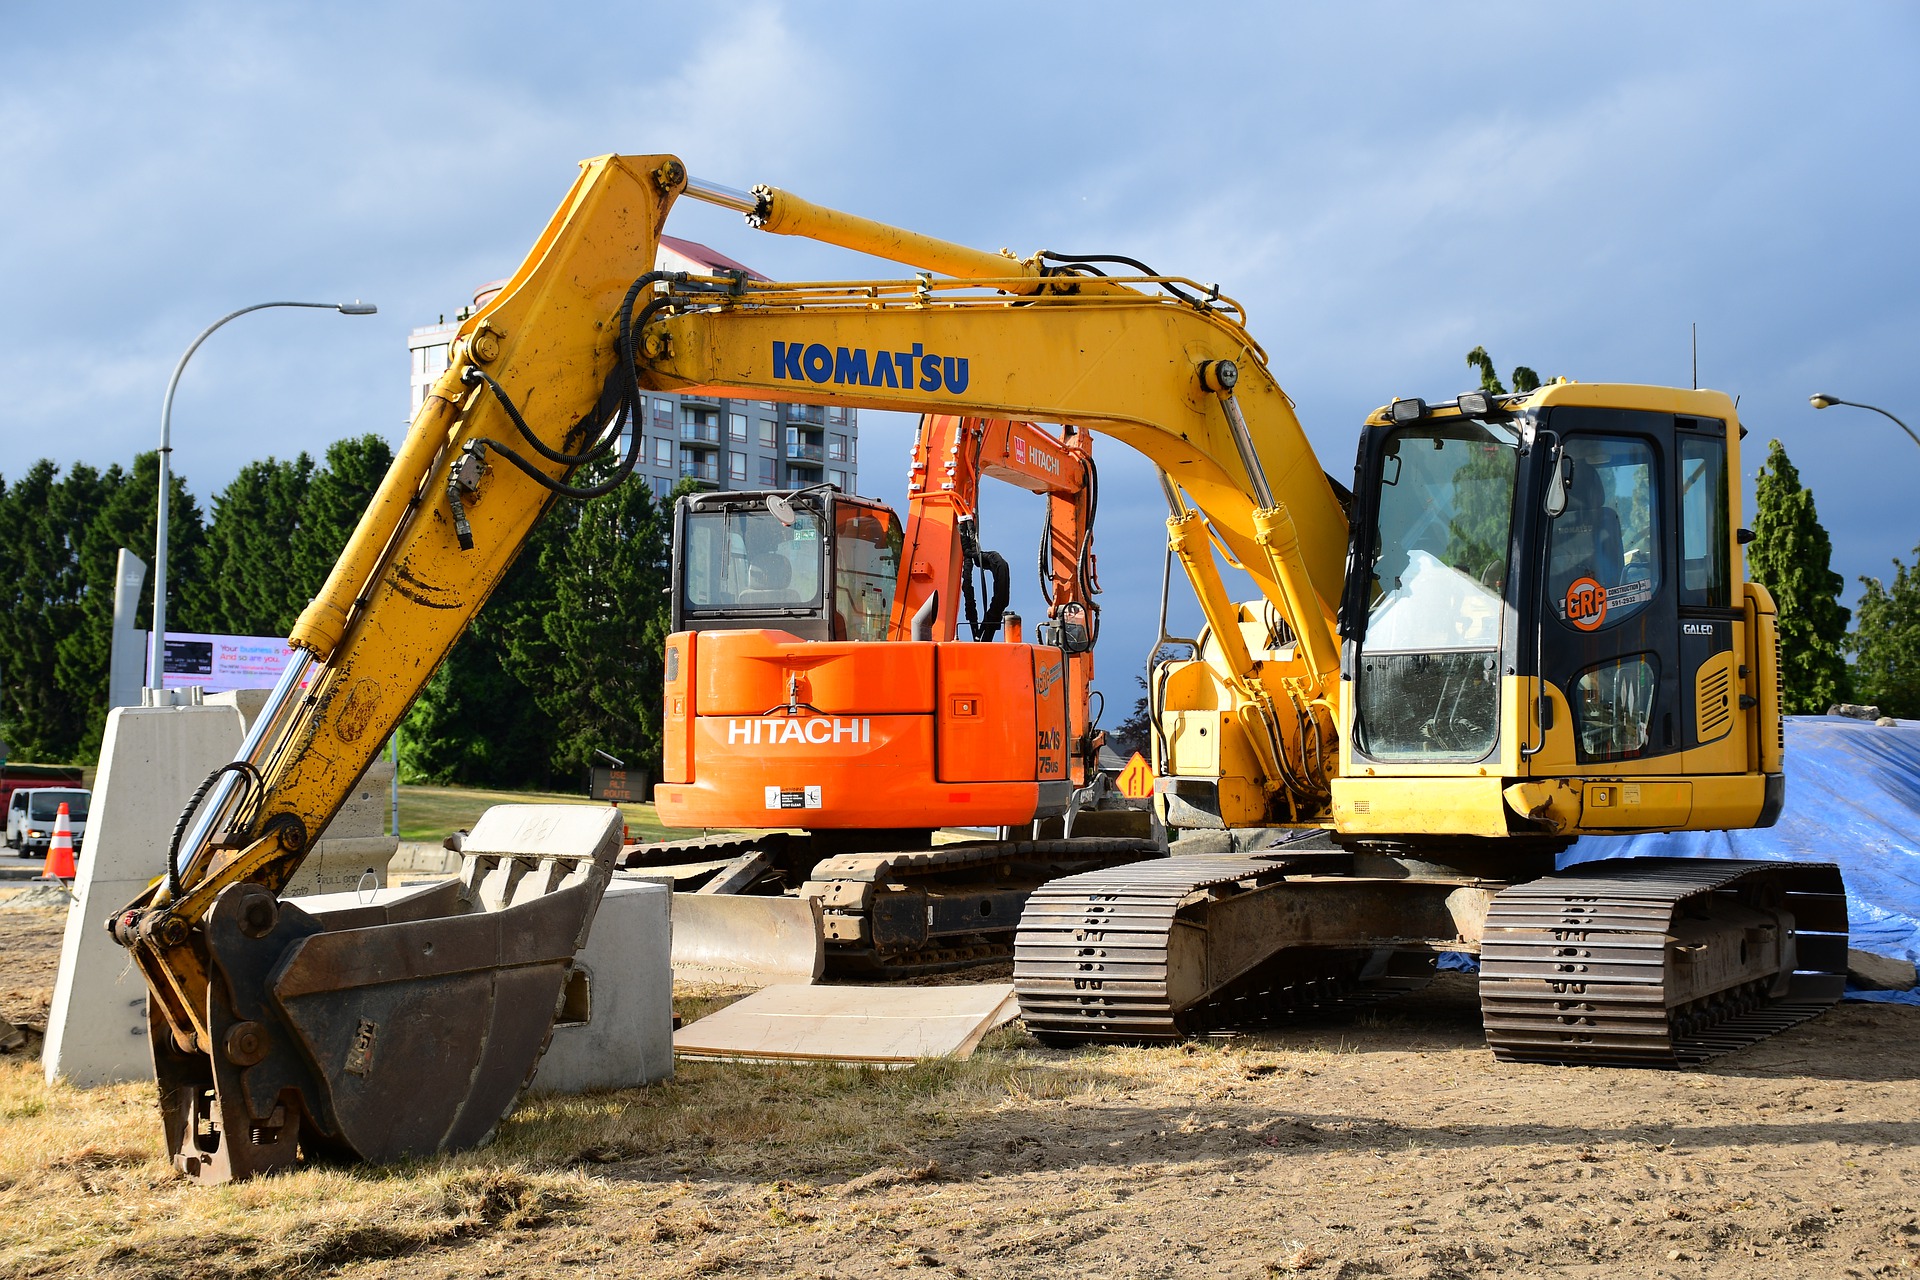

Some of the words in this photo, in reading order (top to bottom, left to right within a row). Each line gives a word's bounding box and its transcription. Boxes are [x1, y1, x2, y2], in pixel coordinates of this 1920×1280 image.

[773, 341, 969, 394] KOMATSU
[1029, 446, 1059, 476] HITACHI
[1608, 584, 1638, 595] CONSTRUCTION
[1567, 586, 1606, 619] GRP
[220, 644, 238, 653] Your
[240, 646, 272, 655] business
[274, 647, 280, 655] is
[220, 653, 237, 661] And
[264, 656, 280, 664] you.
[728, 718, 870, 744] HITACHI
[1039, 727, 1060, 750] ZAXIS
[610, 771, 626, 779] USE
[603, 789, 631, 799] ROUTE
